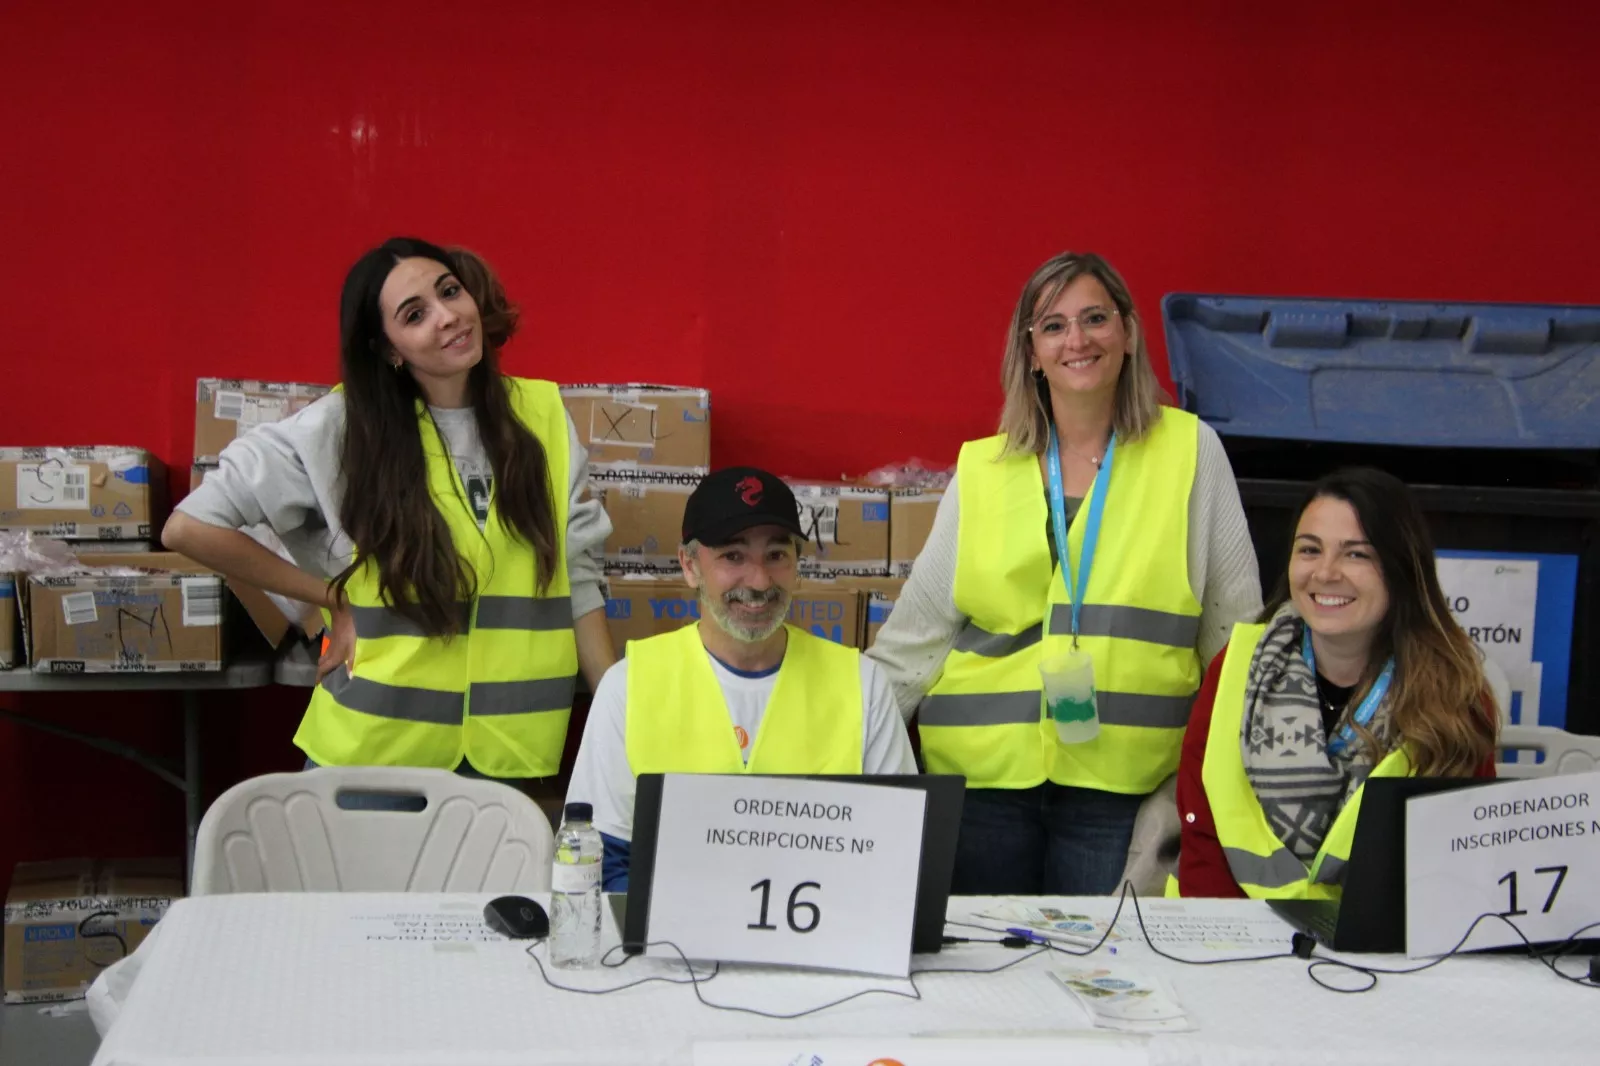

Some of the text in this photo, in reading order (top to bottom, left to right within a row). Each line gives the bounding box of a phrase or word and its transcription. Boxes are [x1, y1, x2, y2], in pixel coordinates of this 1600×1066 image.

[1446, 596, 1470, 613] LO
[1469, 623, 1522, 644] RTÓN
[733, 798, 853, 821] ORDENADOR
[1473, 793, 1590, 821] ORDENADOR
[706, 828, 845, 853] INSCRIPCIONES
[1450, 820, 1600, 852] INSCRIPCIONES N
[1497, 865, 1569, 917] 17
[747, 878, 822, 934] 16
[38, 927, 71, 940] ROLY
